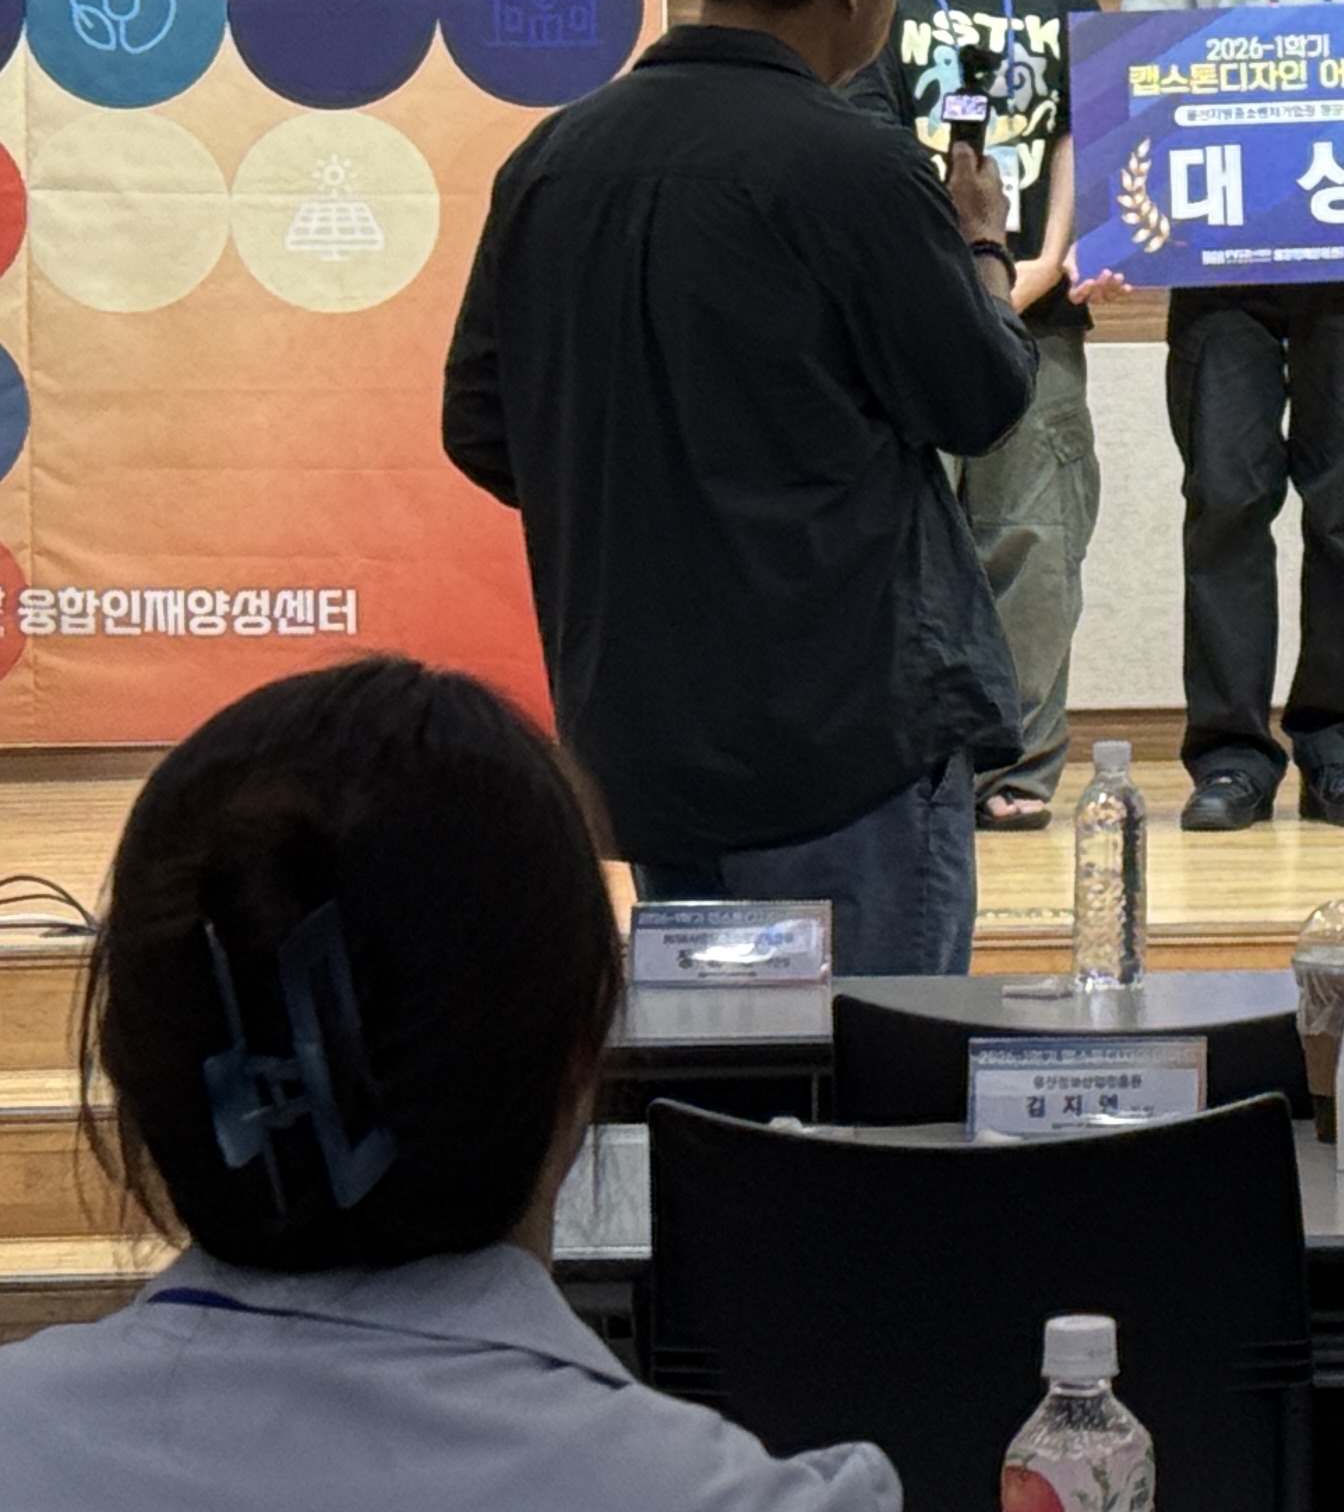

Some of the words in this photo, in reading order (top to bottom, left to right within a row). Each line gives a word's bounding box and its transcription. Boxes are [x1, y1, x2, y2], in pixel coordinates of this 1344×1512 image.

[1205, 34, 1330, 61] 2026-1학기
[1129, 59, 1308, 97] 캡스톤디자인
[18, 587, 357, 635] 융합인재양성센터
